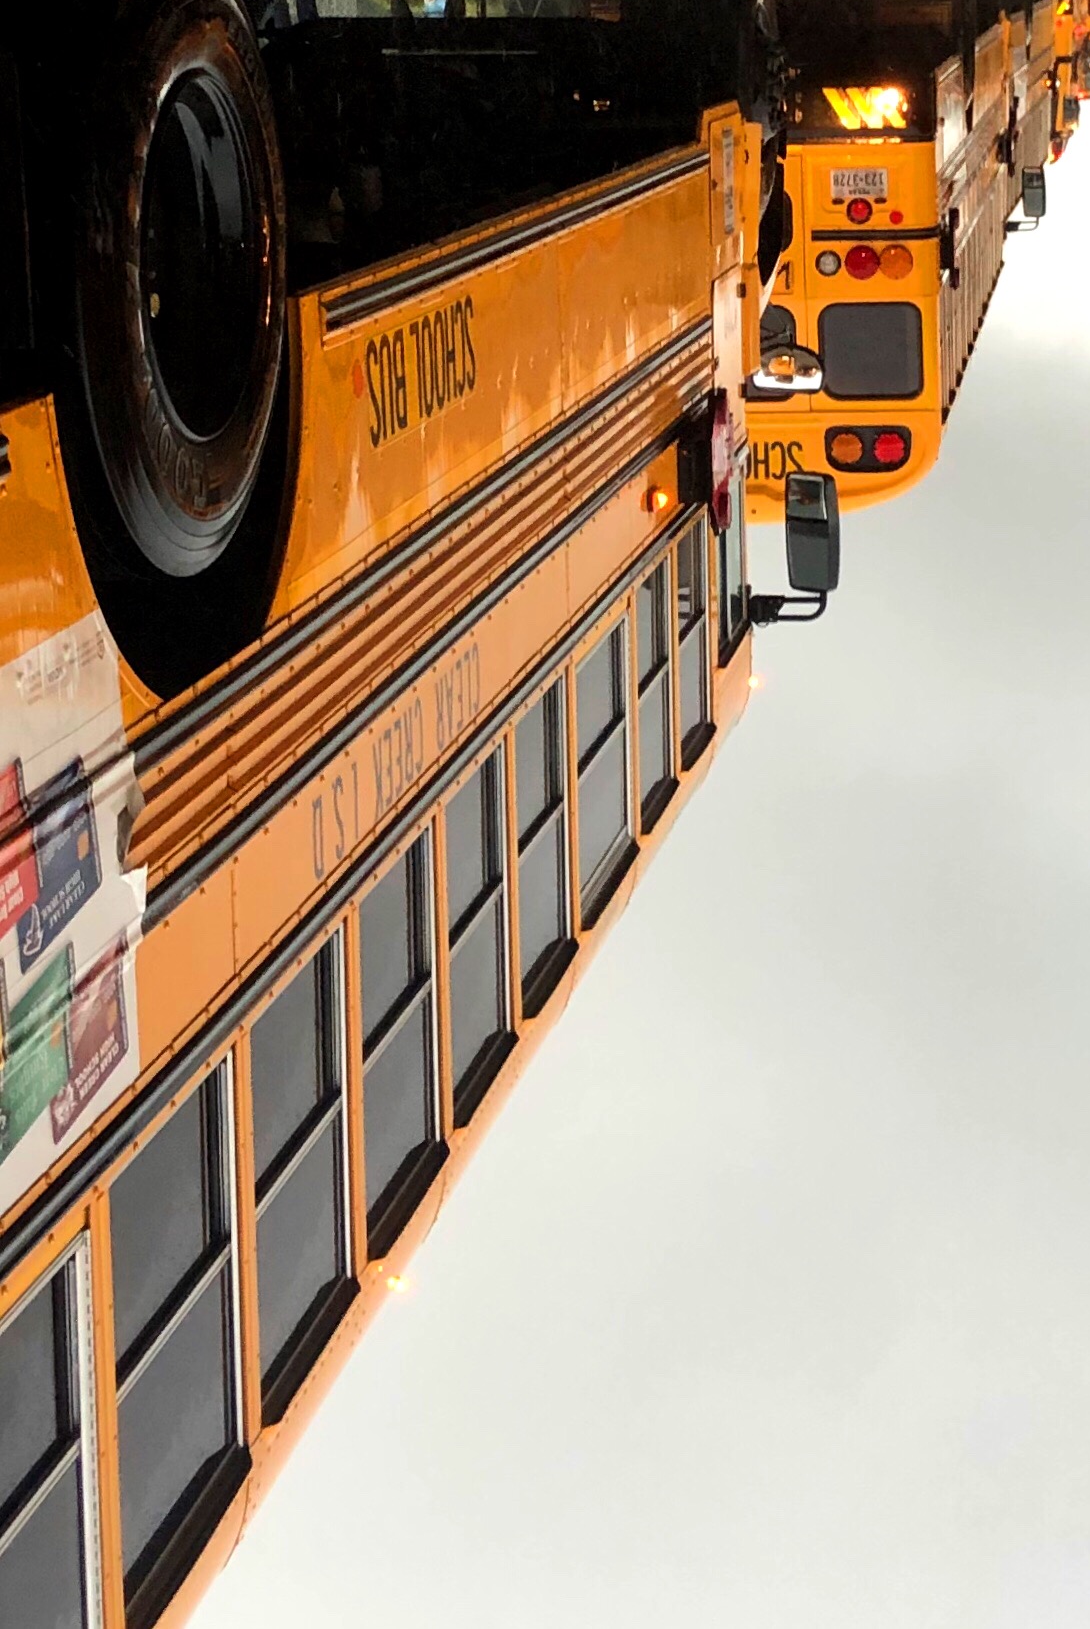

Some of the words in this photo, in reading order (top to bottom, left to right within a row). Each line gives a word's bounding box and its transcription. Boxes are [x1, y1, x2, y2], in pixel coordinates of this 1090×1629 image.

[364, 328, 408, 448] BUS
[409, 294, 476, 391] SCHOOL
[746, 441, 805, 481] SCH
[435, 642, 480, 752] CLEAR
[372, 696, 424, 824] CREEK
[79, 1068, 100, 1102] CREEK
[100, 1041, 119, 1073] CLEAR
